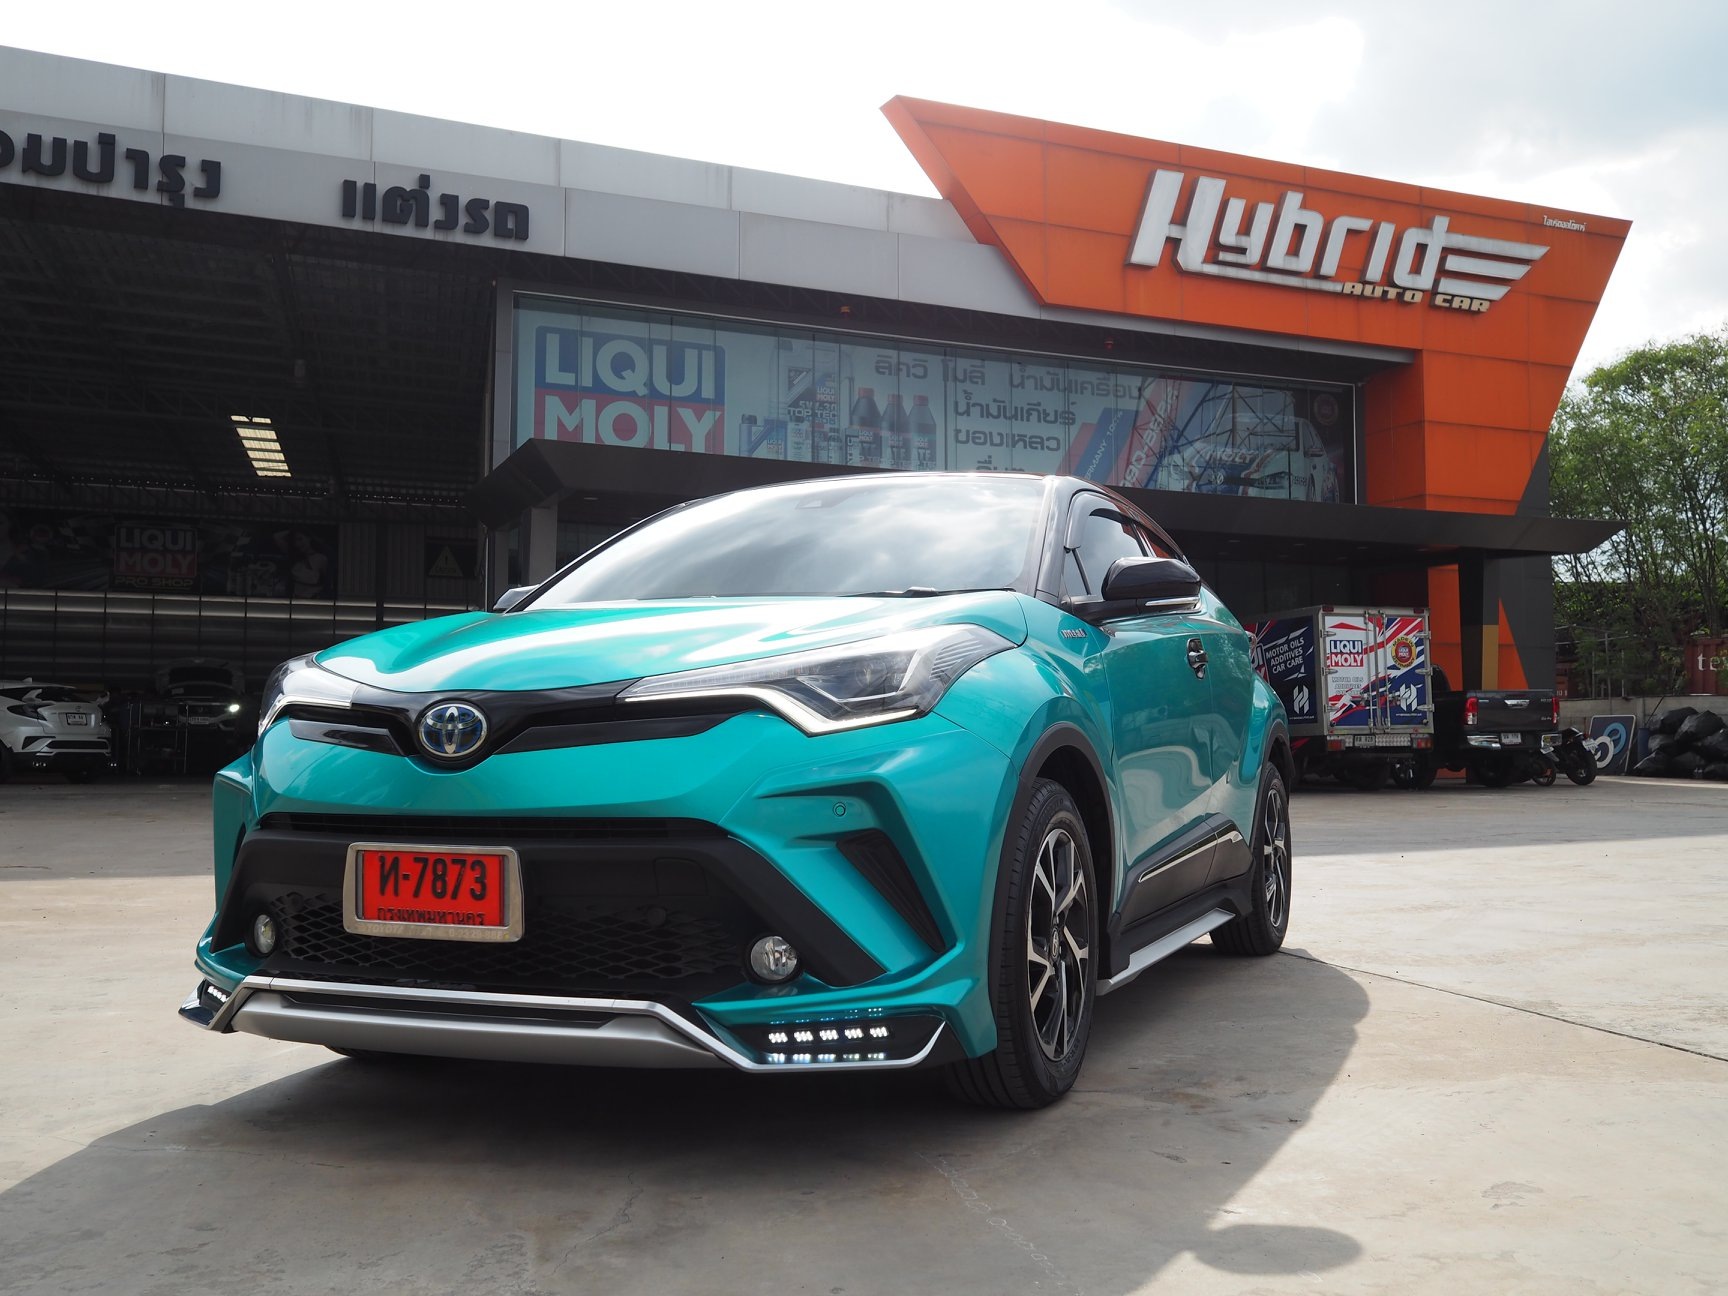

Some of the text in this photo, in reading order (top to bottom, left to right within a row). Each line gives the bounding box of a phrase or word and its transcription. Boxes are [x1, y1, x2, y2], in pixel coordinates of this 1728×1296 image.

[342, 174, 530, 240] แต่งรถ
[1128, 169, 1452, 293] Hybrid
[1342, 283, 1490, 312] AUTO CAR
[545, 333, 716, 400] LIQUI
[546, 395, 724, 452] MOLY
[954, 428, 1061, 452] ของเหลว
[119, 527, 192, 551] LIQUI
[119, 551, 195, 574] MOLY
[114, 576, 193, 589] PRO SHOP
[1266, 637, 1305, 660] MOTOR OILS
[1270, 648, 1304, 667] ADDITIVES
[1330, 640, 1361, 653] LIQUI
[1272, 656, 1304, 674] CAR CARE
[1331, 653, 1363, 667] MOLY
[377, 907, 486, 926] กรงเทพมหานคร
